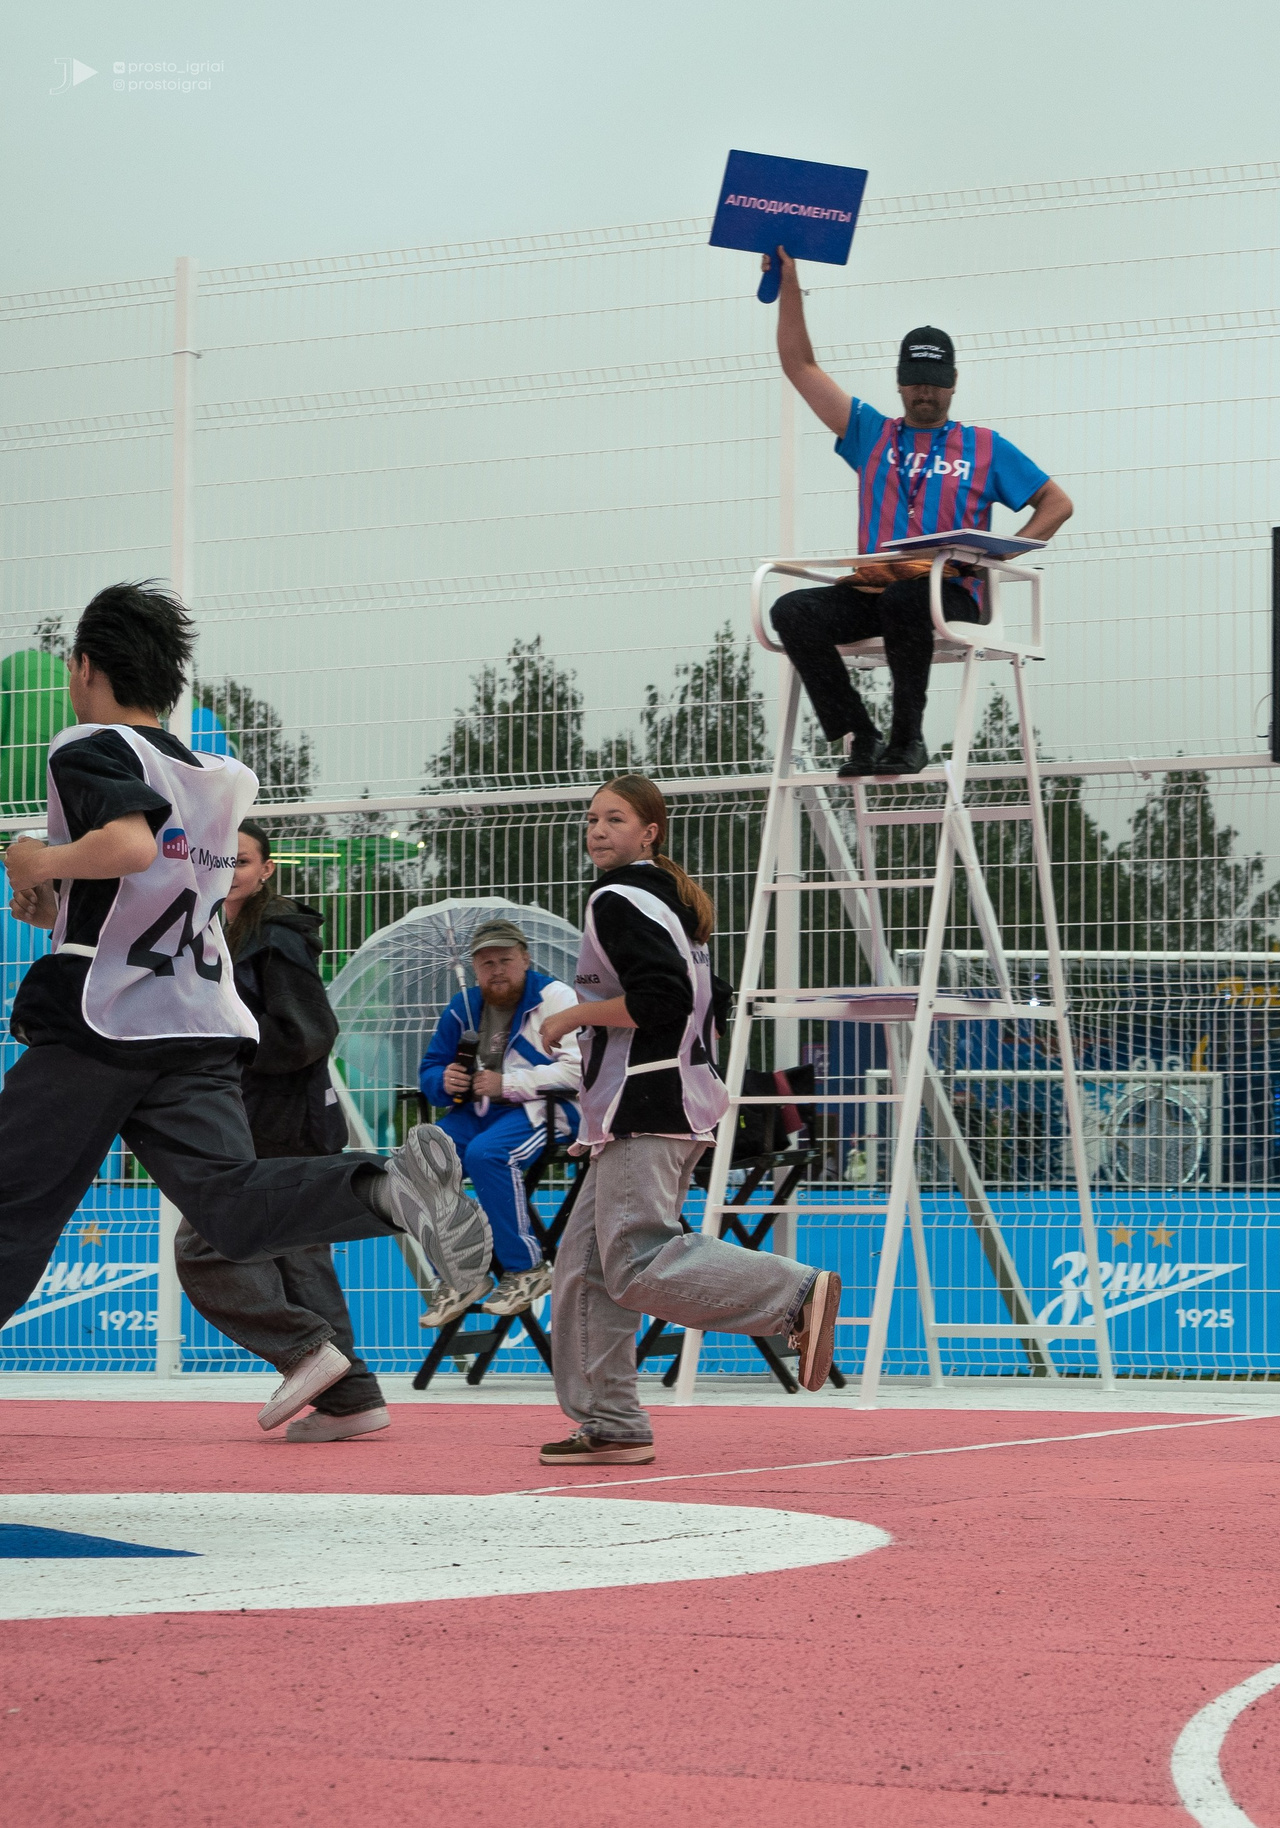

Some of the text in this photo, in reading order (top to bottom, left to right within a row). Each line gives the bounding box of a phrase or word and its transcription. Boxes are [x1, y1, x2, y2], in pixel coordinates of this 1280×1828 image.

[724, 194, 852, 223] АПЛОДИСМЕНТЫ
[1034, 1251, 1246, 1344] Зенит
[98, 1310, 160, 1331] 1925
[1175, 1308, 1235, 1329] 1925
